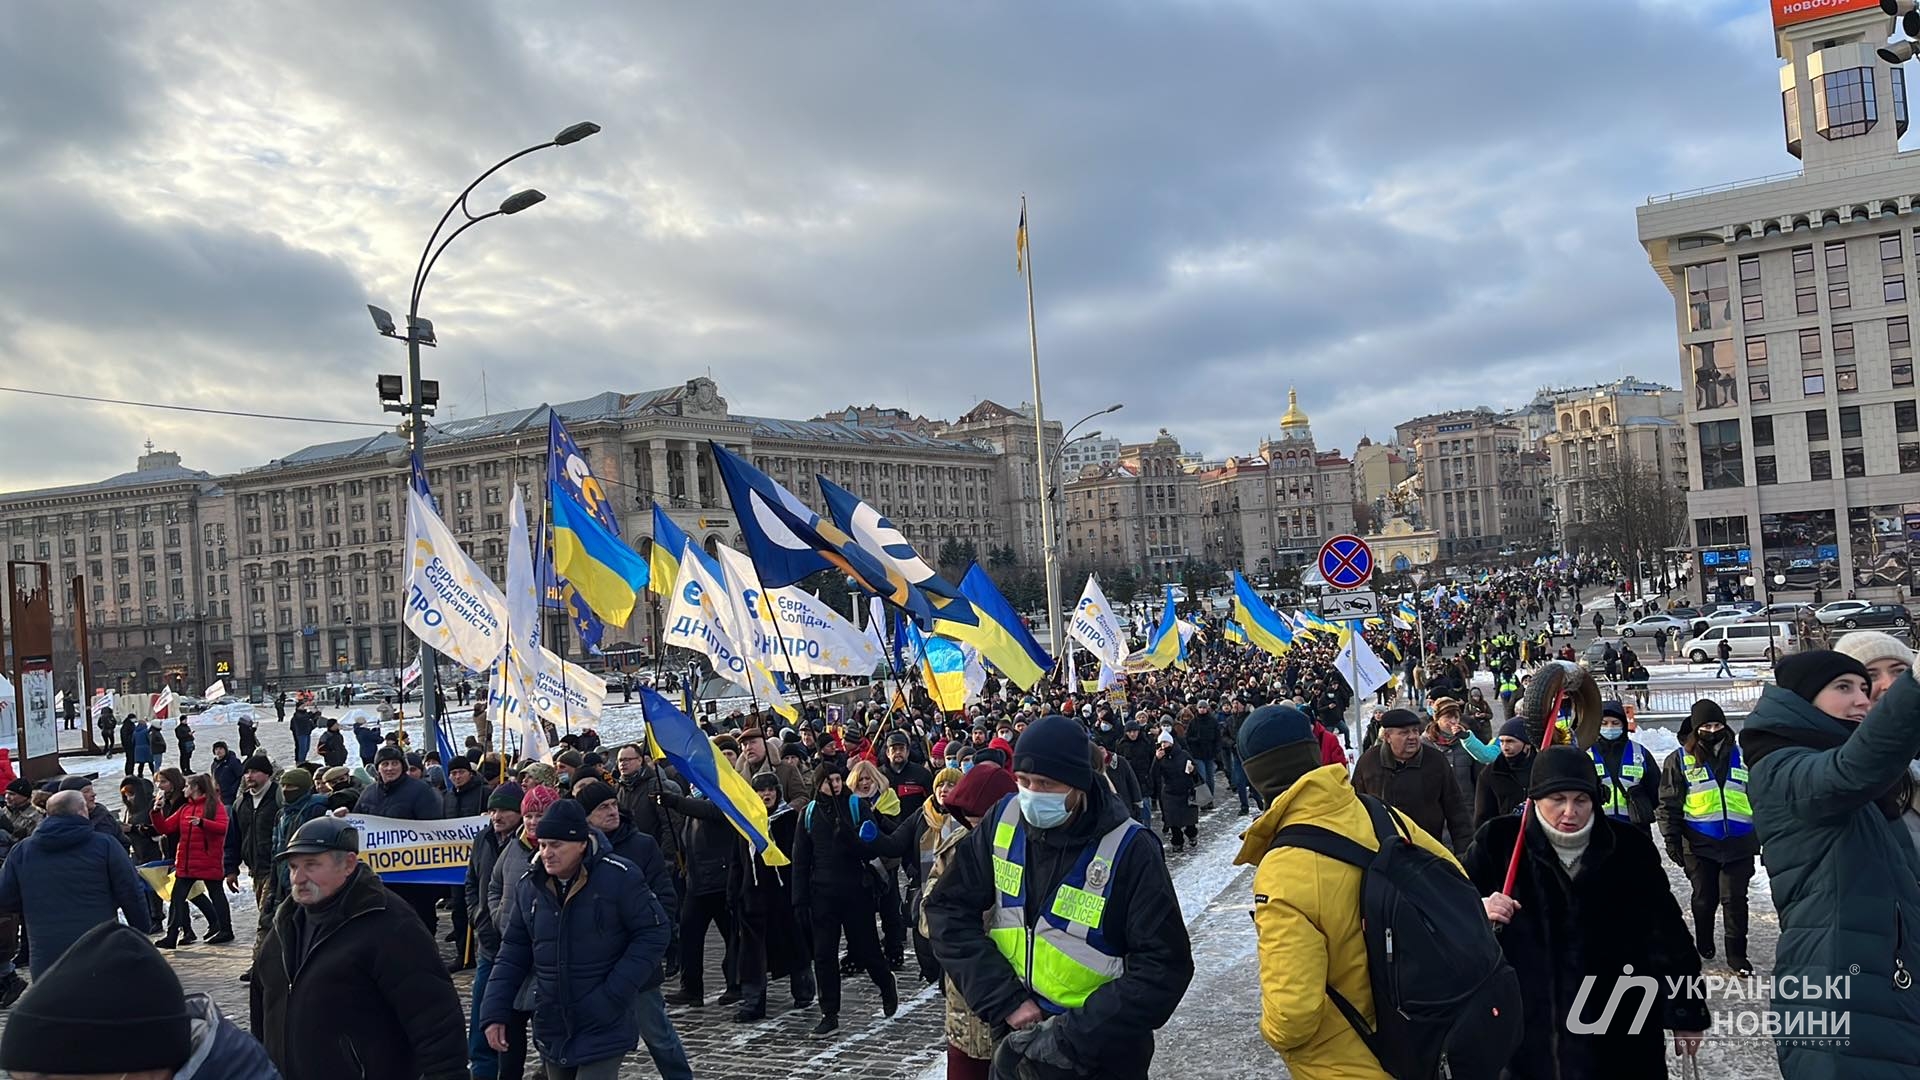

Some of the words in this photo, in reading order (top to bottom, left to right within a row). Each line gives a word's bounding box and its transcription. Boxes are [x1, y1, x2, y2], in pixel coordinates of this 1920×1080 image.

[424, 565, 492, 637] Солідарність
[432, 556, 499, 629] Європейська
[671, 616, 745, 673] ДНІПРО
[216, 661, 229, 672] 24
[366, 829, 418, 849] ДНІПРО
[418, 831, 434, 842] та
[433, 822, 489, 842] УКРАЇН
[1058, 886, 1105, 911] DIALOGUE
[1059, 902, 1093, 924] POLICE
